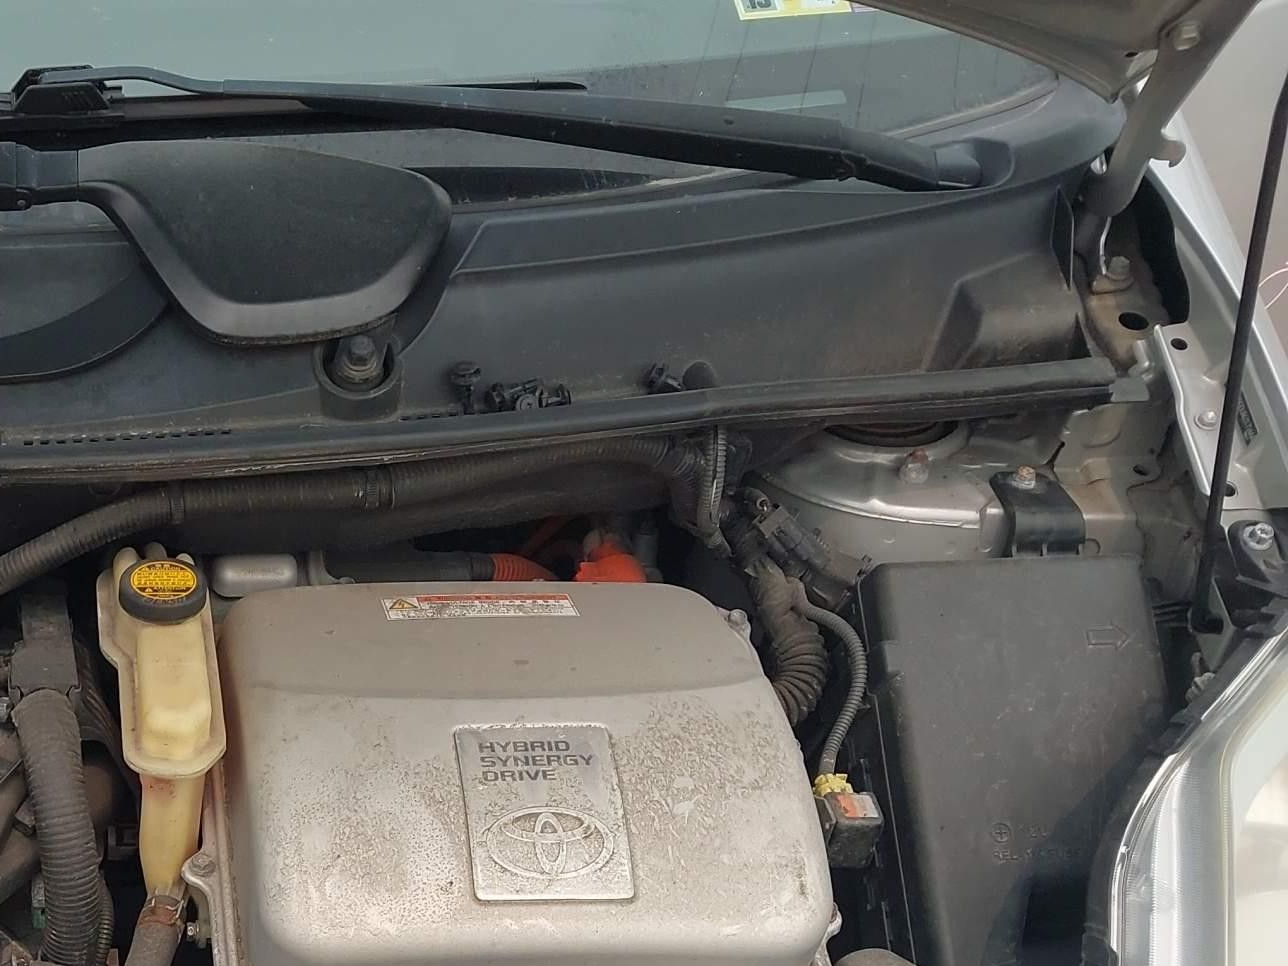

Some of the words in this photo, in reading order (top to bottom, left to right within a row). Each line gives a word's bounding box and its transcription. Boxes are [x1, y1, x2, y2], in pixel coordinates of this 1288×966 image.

[478, 740, 571, 753] HYBRID
[479, 754, 594, 768] SYNERGY
[481, 769, 558, 782] DRIVE
